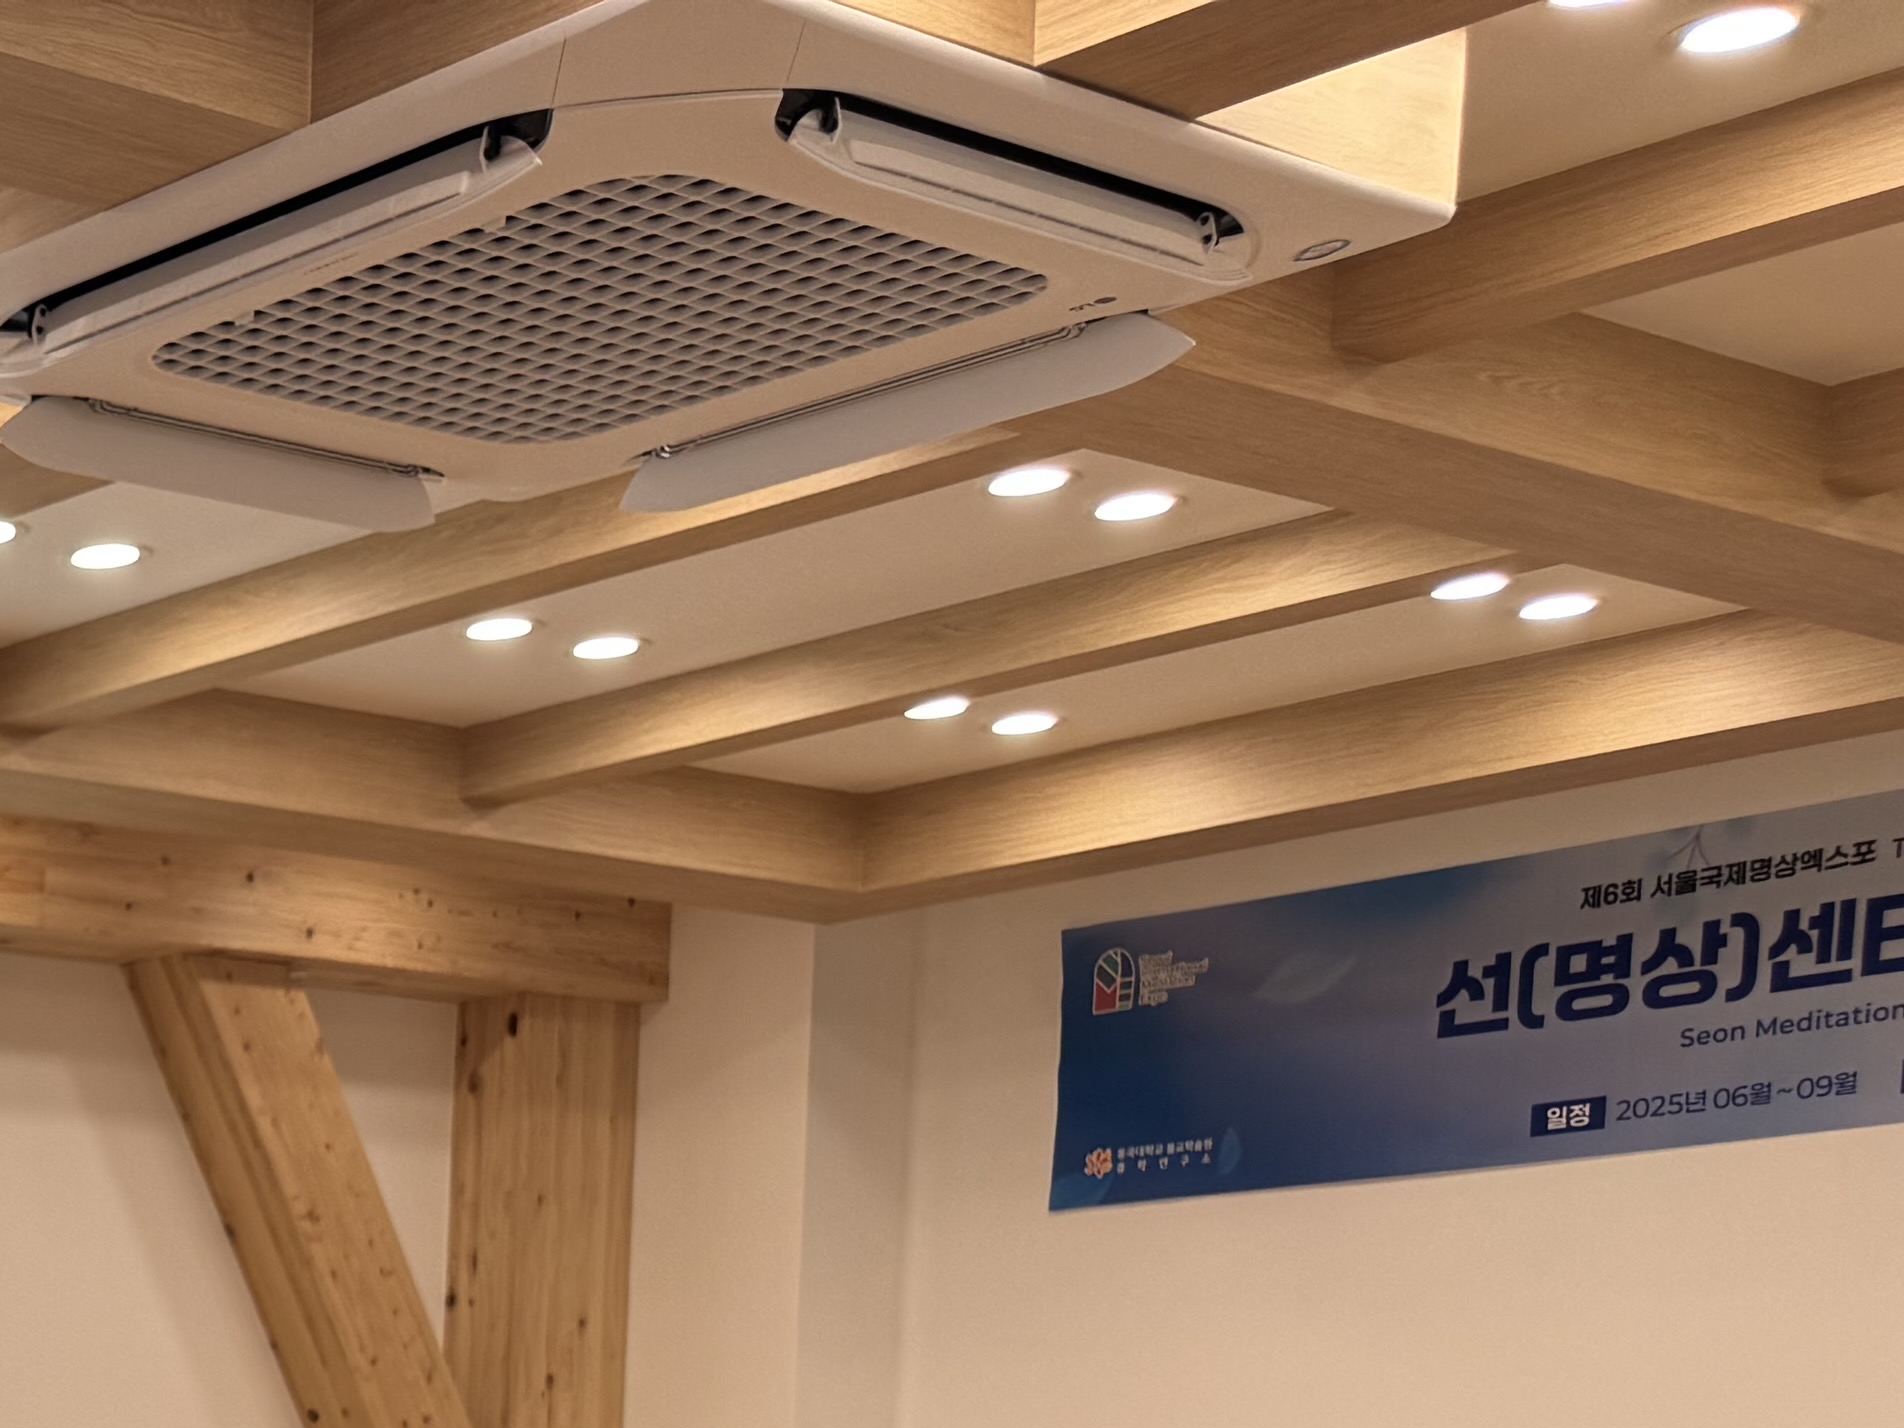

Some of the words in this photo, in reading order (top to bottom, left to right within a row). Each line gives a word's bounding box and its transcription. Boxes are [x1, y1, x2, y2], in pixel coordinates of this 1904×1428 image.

[1580, 877, 1642, 909] 제6회
[1650, 838, 1877, 898] 서울국제명상엑스포
[1679, 1023, 1746, 1048] Seon
[1545, 1102, 1591, 1131] 일정
[1615, 1088, 1707, 1121] 2025년
